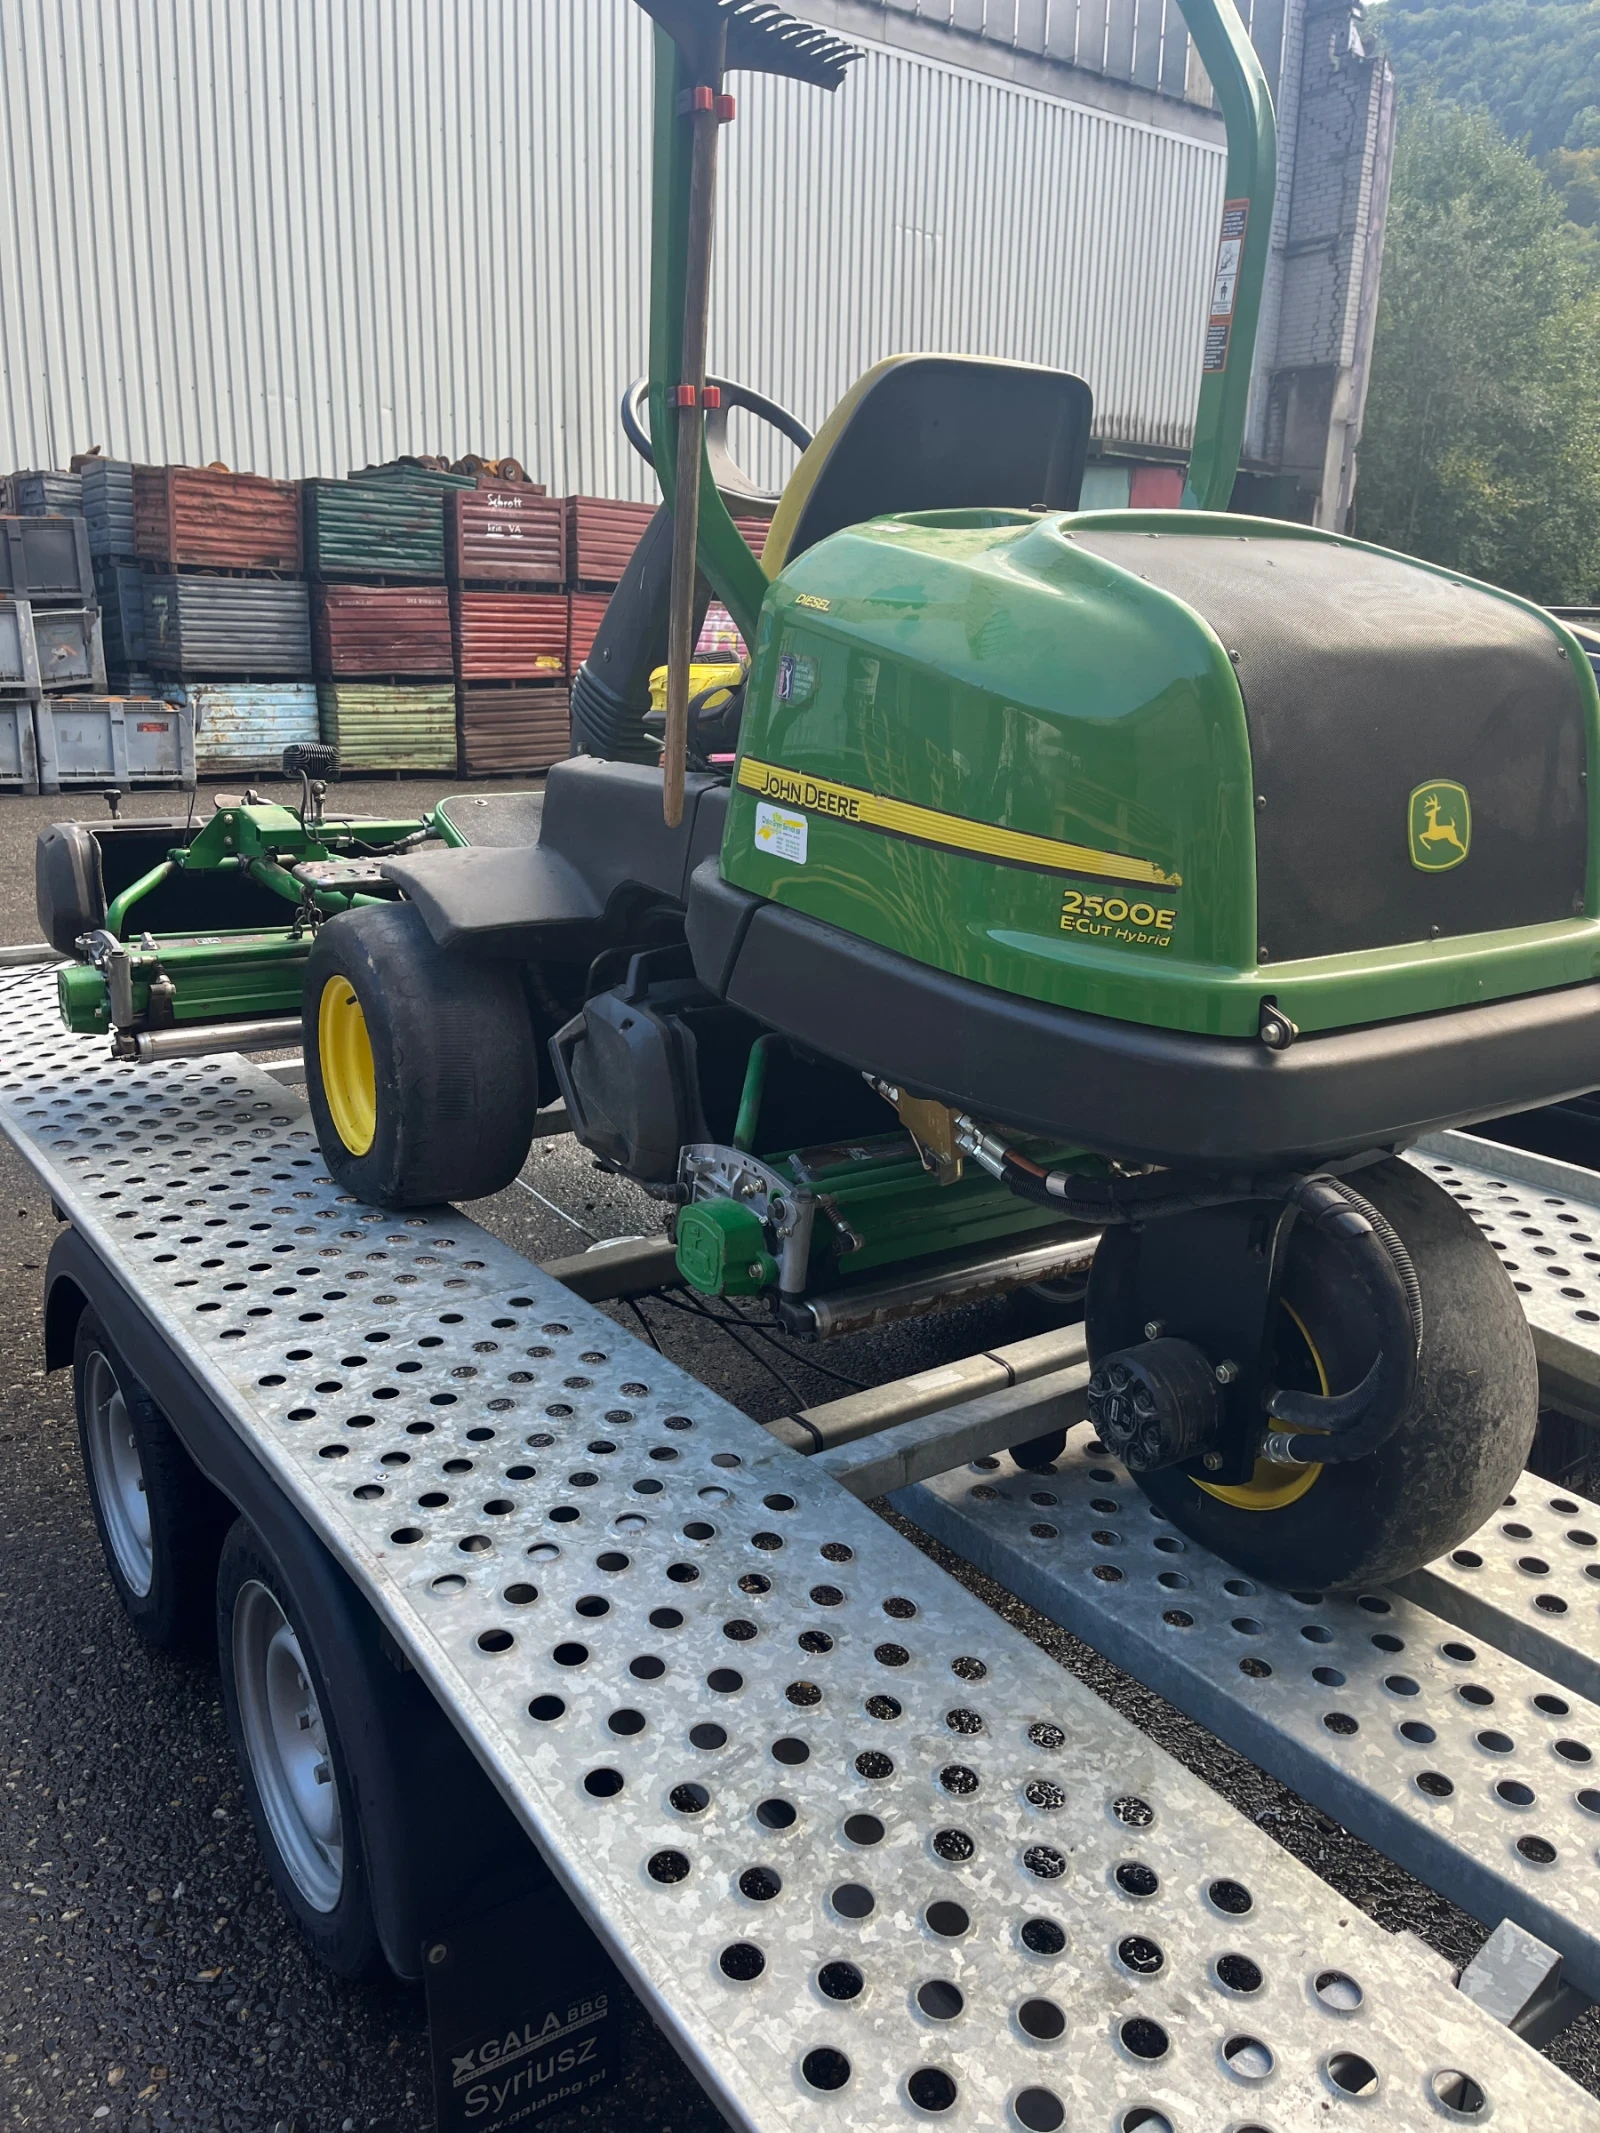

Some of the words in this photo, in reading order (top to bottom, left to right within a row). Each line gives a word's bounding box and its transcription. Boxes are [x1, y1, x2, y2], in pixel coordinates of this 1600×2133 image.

[487, 493, 523, 508] Schrott
[508, 524, 521, 533] VA
[794, 593, 831, 611] DIESEL
[761, 771, 801, 802] JOHN
[804, 782, 860, 818] DEERE
[1061, 890, 1177, 931] 2500E
[1114, 928, 1171, 947] Hybrid
[479, 2012, 562, 2064] GALA
[567, 1995, 608, 2024] BBG
[464, 2036, 598, 2118] Syriusz
